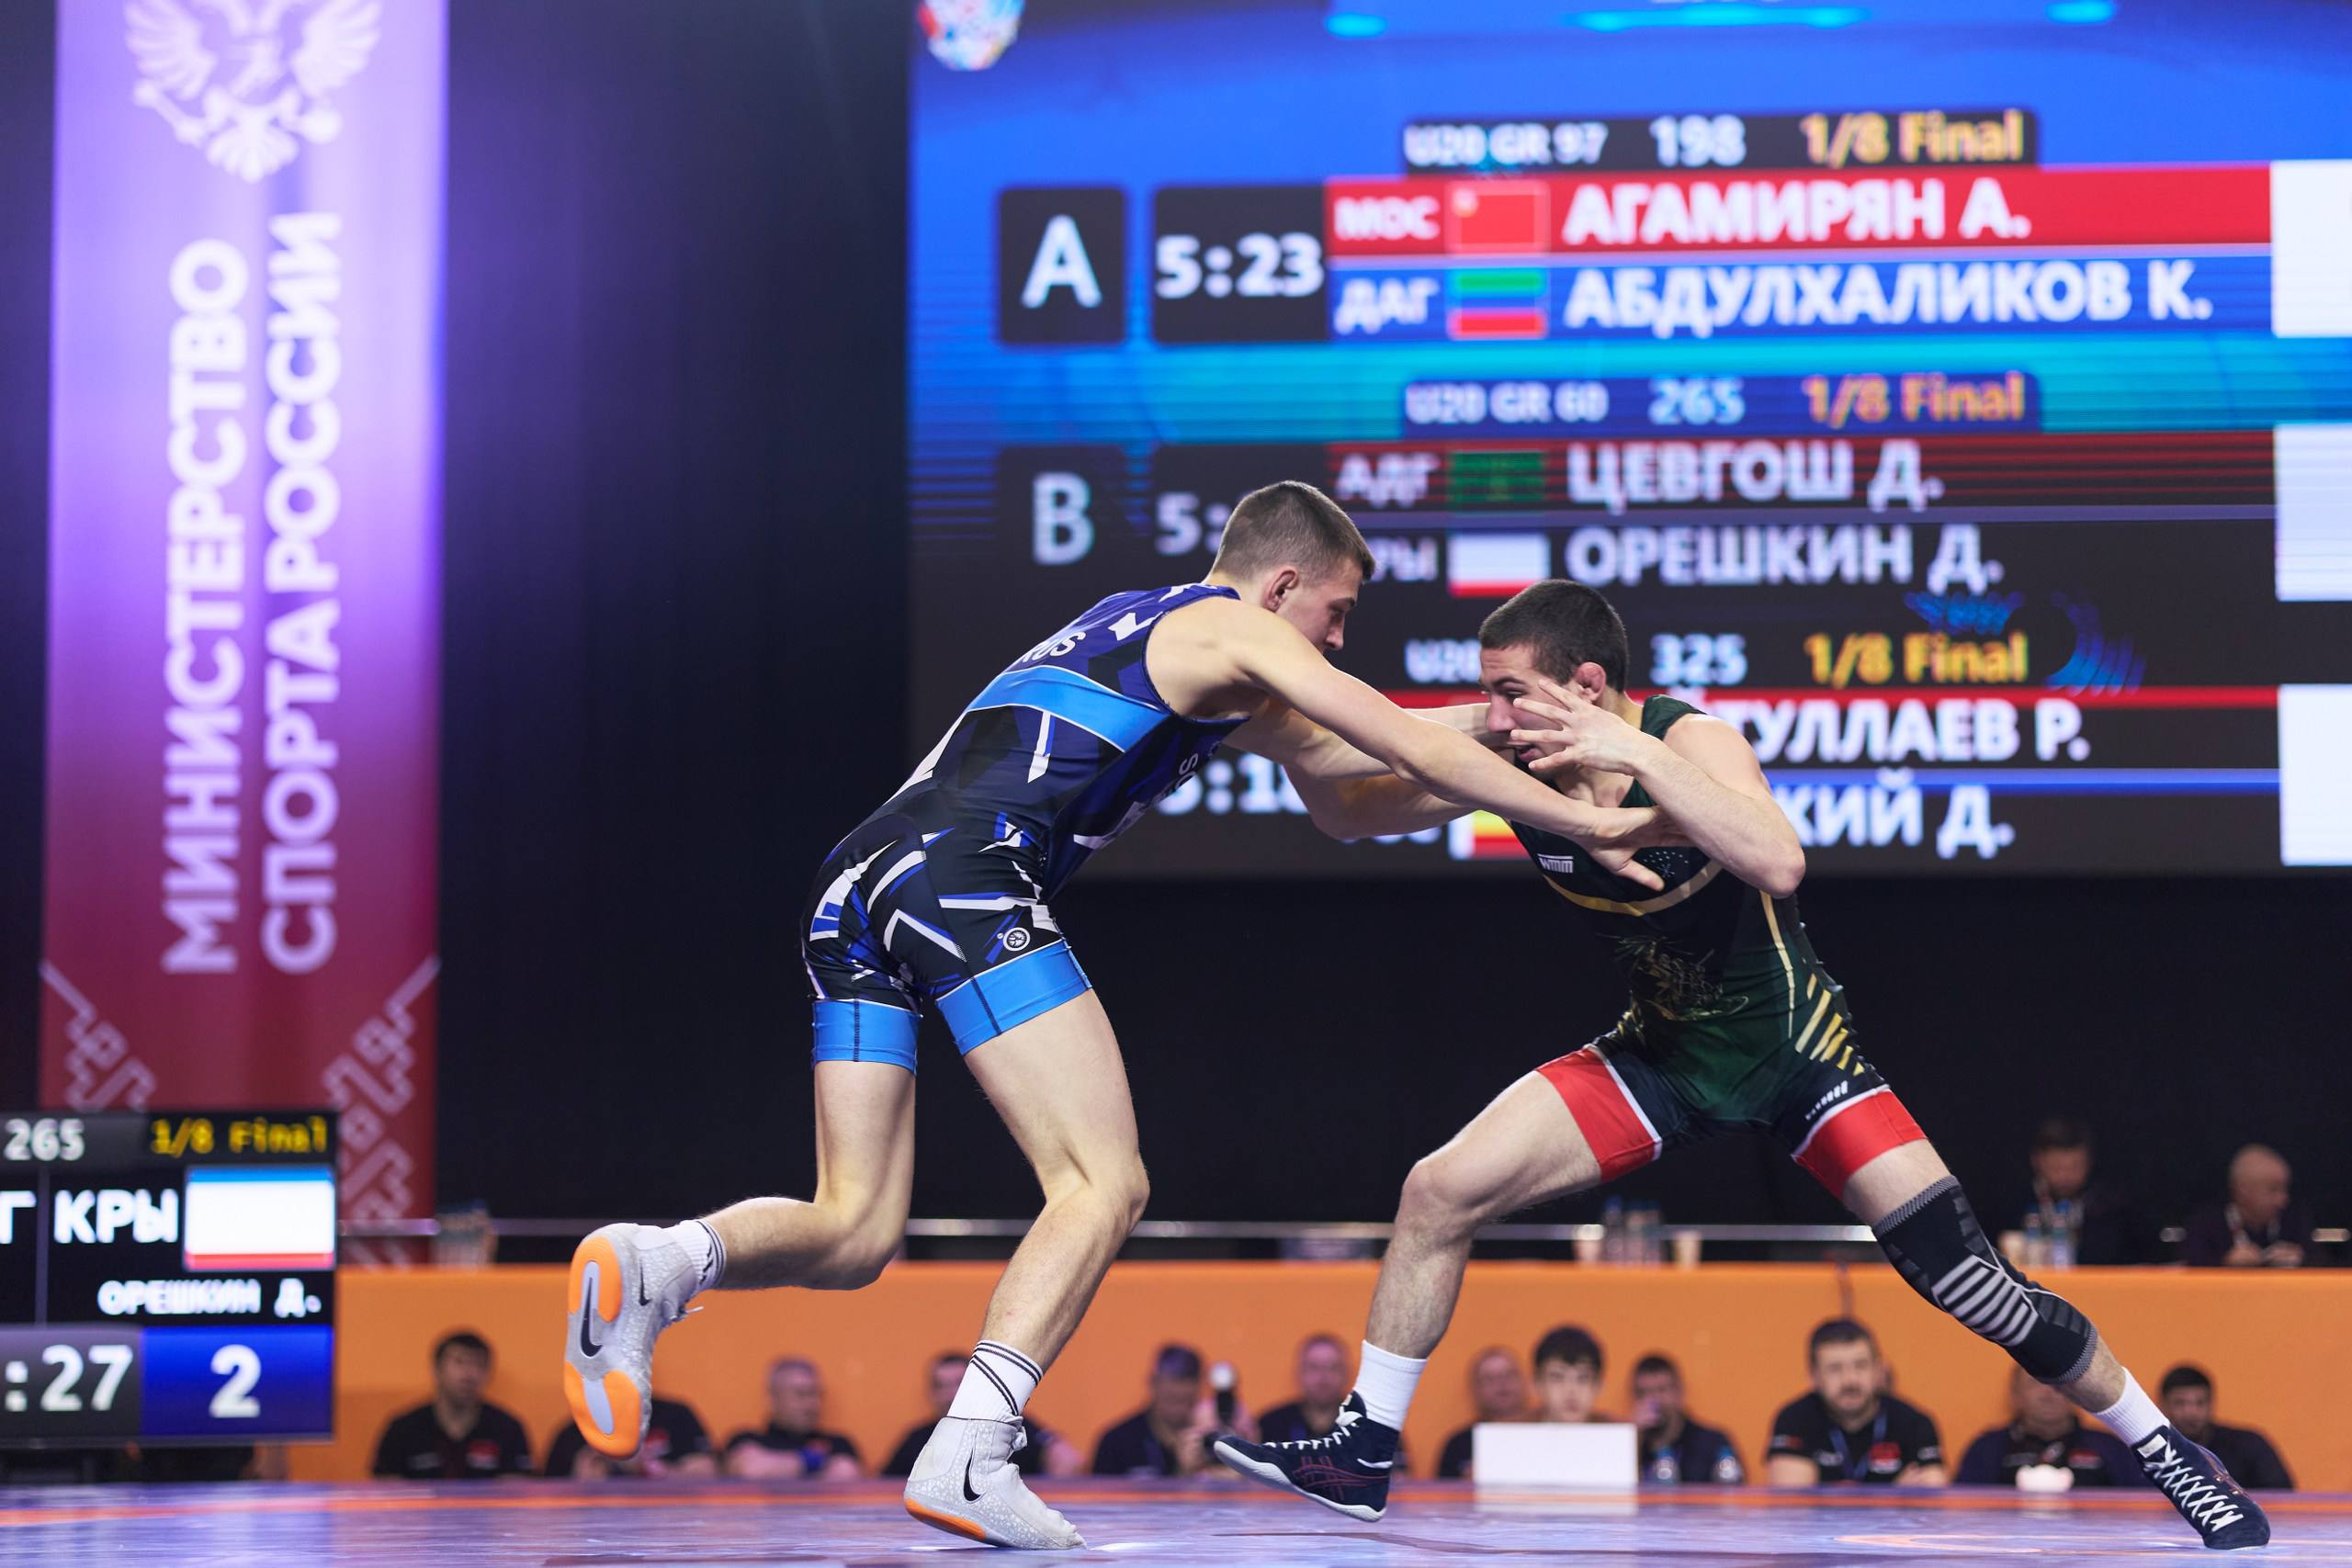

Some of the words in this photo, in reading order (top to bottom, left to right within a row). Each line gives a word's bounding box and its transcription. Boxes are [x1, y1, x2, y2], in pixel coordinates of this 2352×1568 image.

[1489, 122, 1552, 164] GR
[1553, 122, 1608, 164] 97
[1650, 115, 1746, 166] 198
[1802, 111, 1889, 168] 1/8
[1900, 109, 2024, 163] Final
[1334, 197, 1439, 240] МОС
[1564, 178, 1945, 244] АГАМИРЯН
[1959, 178, 2031, 240] А.
[1155, 232, 1324, 299] 5:23
[1333, 278, 1439, 334] ДАГ
[1564, 260, 2131, 338] АБДУЛХАЛИКОВ
[2148, 259, 2212, 321] К.
[263, 211, 343, 594] РОССИИ
[1649, 378, 1746, 426] 265
[1804, 376, 1889, 429] 1/8
[1902, 372, 2025, 422] Final
[1566, 441, 1854, 513] ЦЕВГОШ
[1867, 439, 1945, 513] Д.
[1155, 492, 1231, 555] 5:
[1368, 535, 1439, 581] РЫ
[1565, 525, 1914, 586] ОРЕШКИН
[1926, 525, 2004, 594] Д.
[161, 239, 250, 975] МИНИСТЕРСТВО
[1651, 634, 1747, 687] 325
[1804, 633, 1891, 688] 1/8
[1905, 631, 2026, 683] Final
[1681, 694, 2018, 761] ТУЛЛАЕВ
[2035, 700, 2091, 760] Р.
[260, 598, 342, 975] СПОРТА
[1773, 767, 1922, 846] КИЙ
[1937, 785, 2016, 860] Д.
[5, 1118, 85, 1161] 265
[151, 1119, 213, 1157] 1/8
[229, 1116, 327, 1154] Final
[53, 1189, 178, 1244] КРЫ
[97, 1279, 262, 1315] ОРЕШКИН
[275, 1278, 321, 1318] Д.
[209, 1344, 263, 1418] 2
